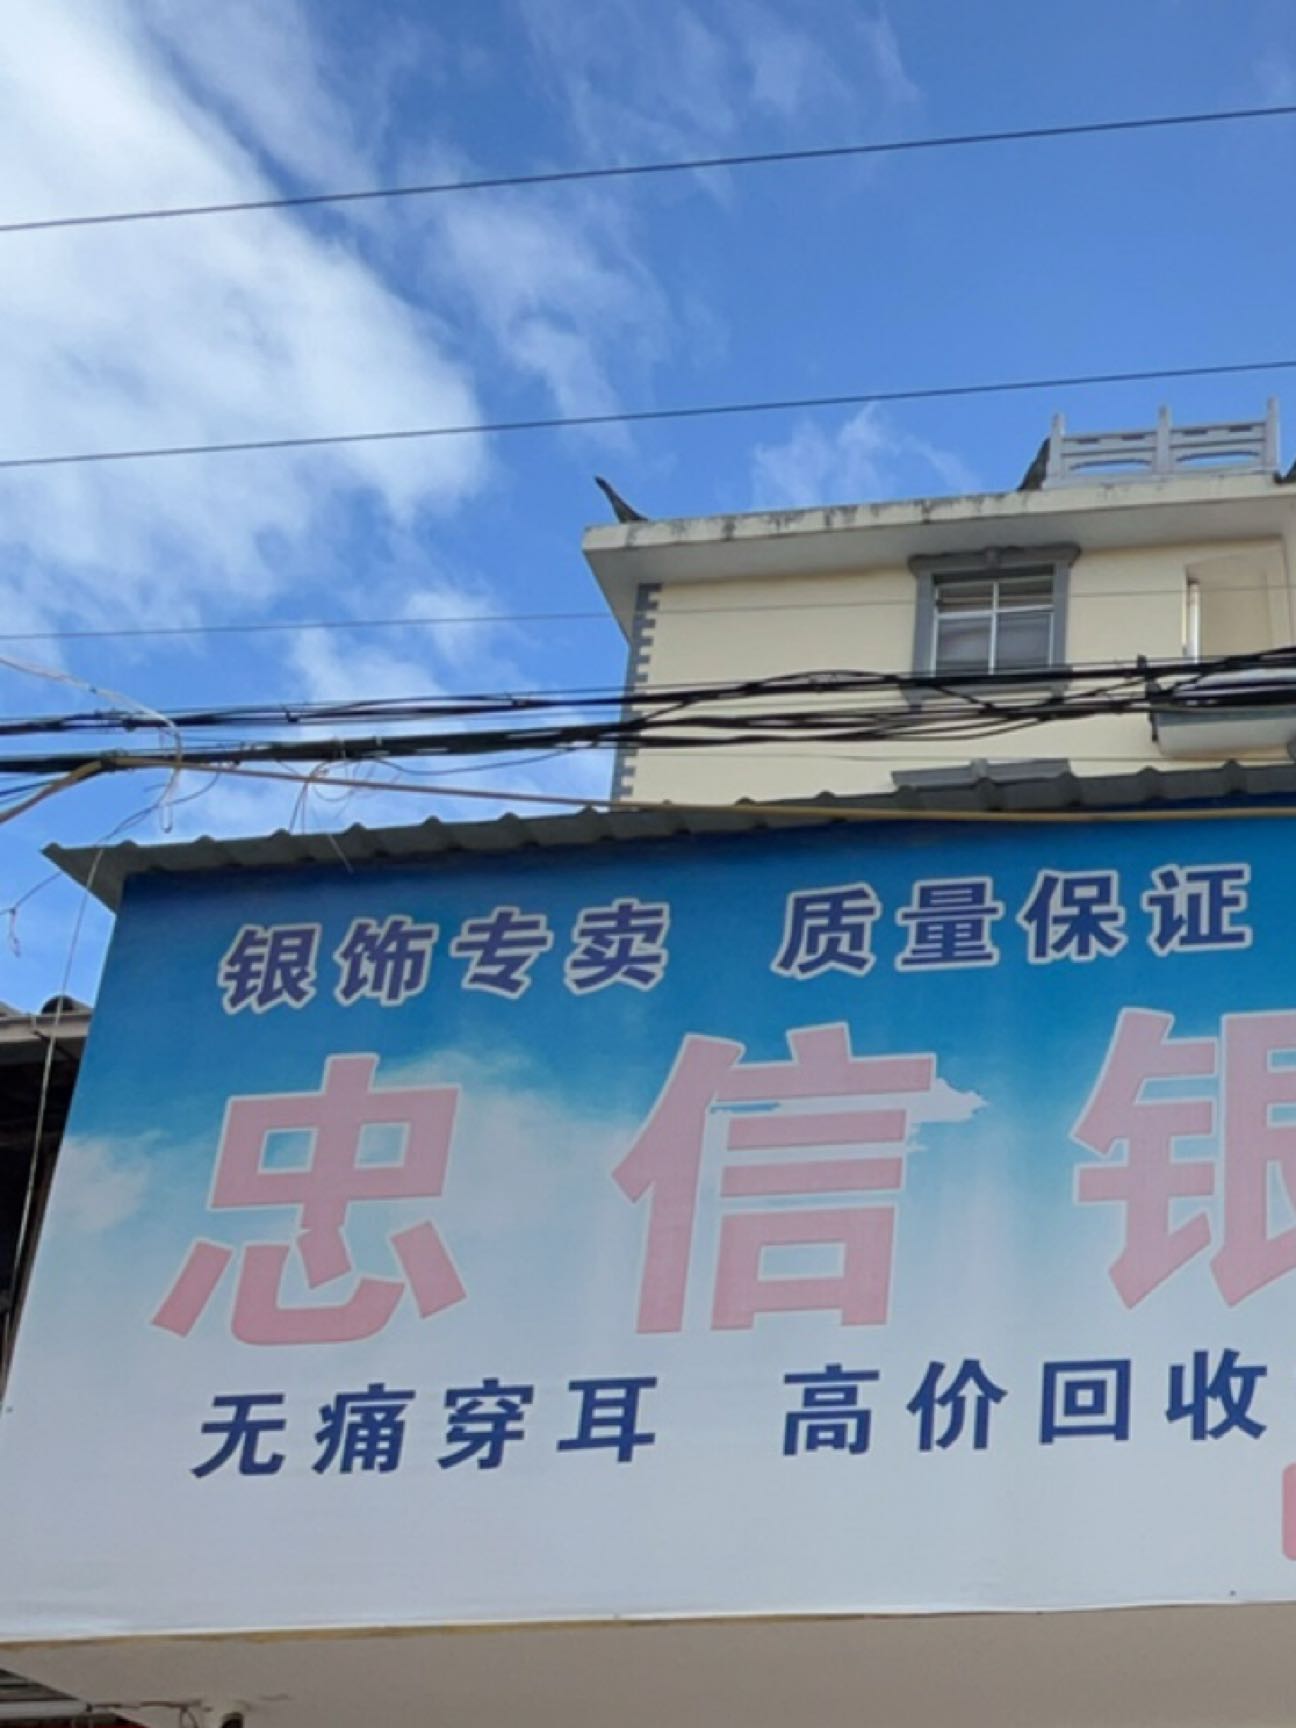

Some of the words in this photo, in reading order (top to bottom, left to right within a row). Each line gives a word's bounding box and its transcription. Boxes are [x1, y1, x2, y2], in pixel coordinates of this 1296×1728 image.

[220, 899, 672, 1014] 银饰专卖
[772, 863, 1253, 979] 质量保证
[193, 1375, 659, 1479] 无痛穿耳
